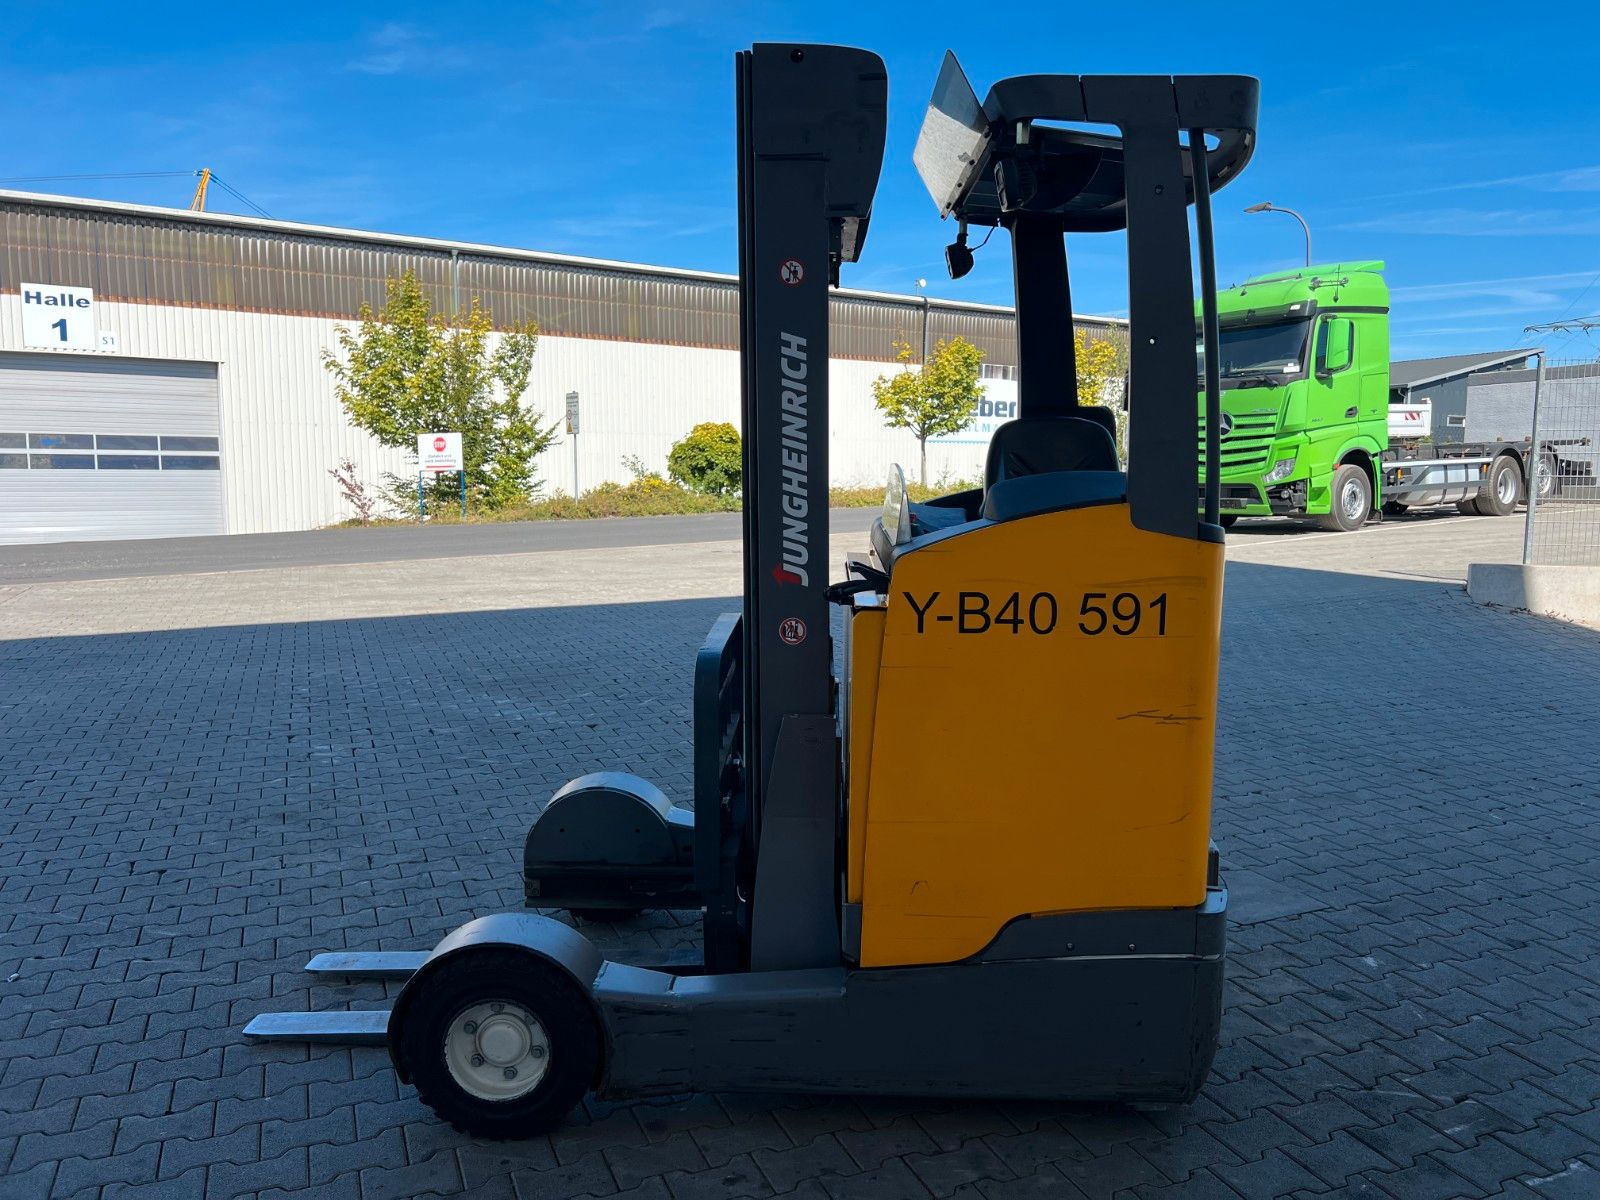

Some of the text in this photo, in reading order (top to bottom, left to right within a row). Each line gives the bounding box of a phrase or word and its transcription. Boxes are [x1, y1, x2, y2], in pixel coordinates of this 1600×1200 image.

[24, 290, 91, 309] Halle
[51, 318, 68, 342] 1
[780, 331, 809, 587] JUNGHEINRICH
[902, 591, 1167, 636] Y-B40 591
